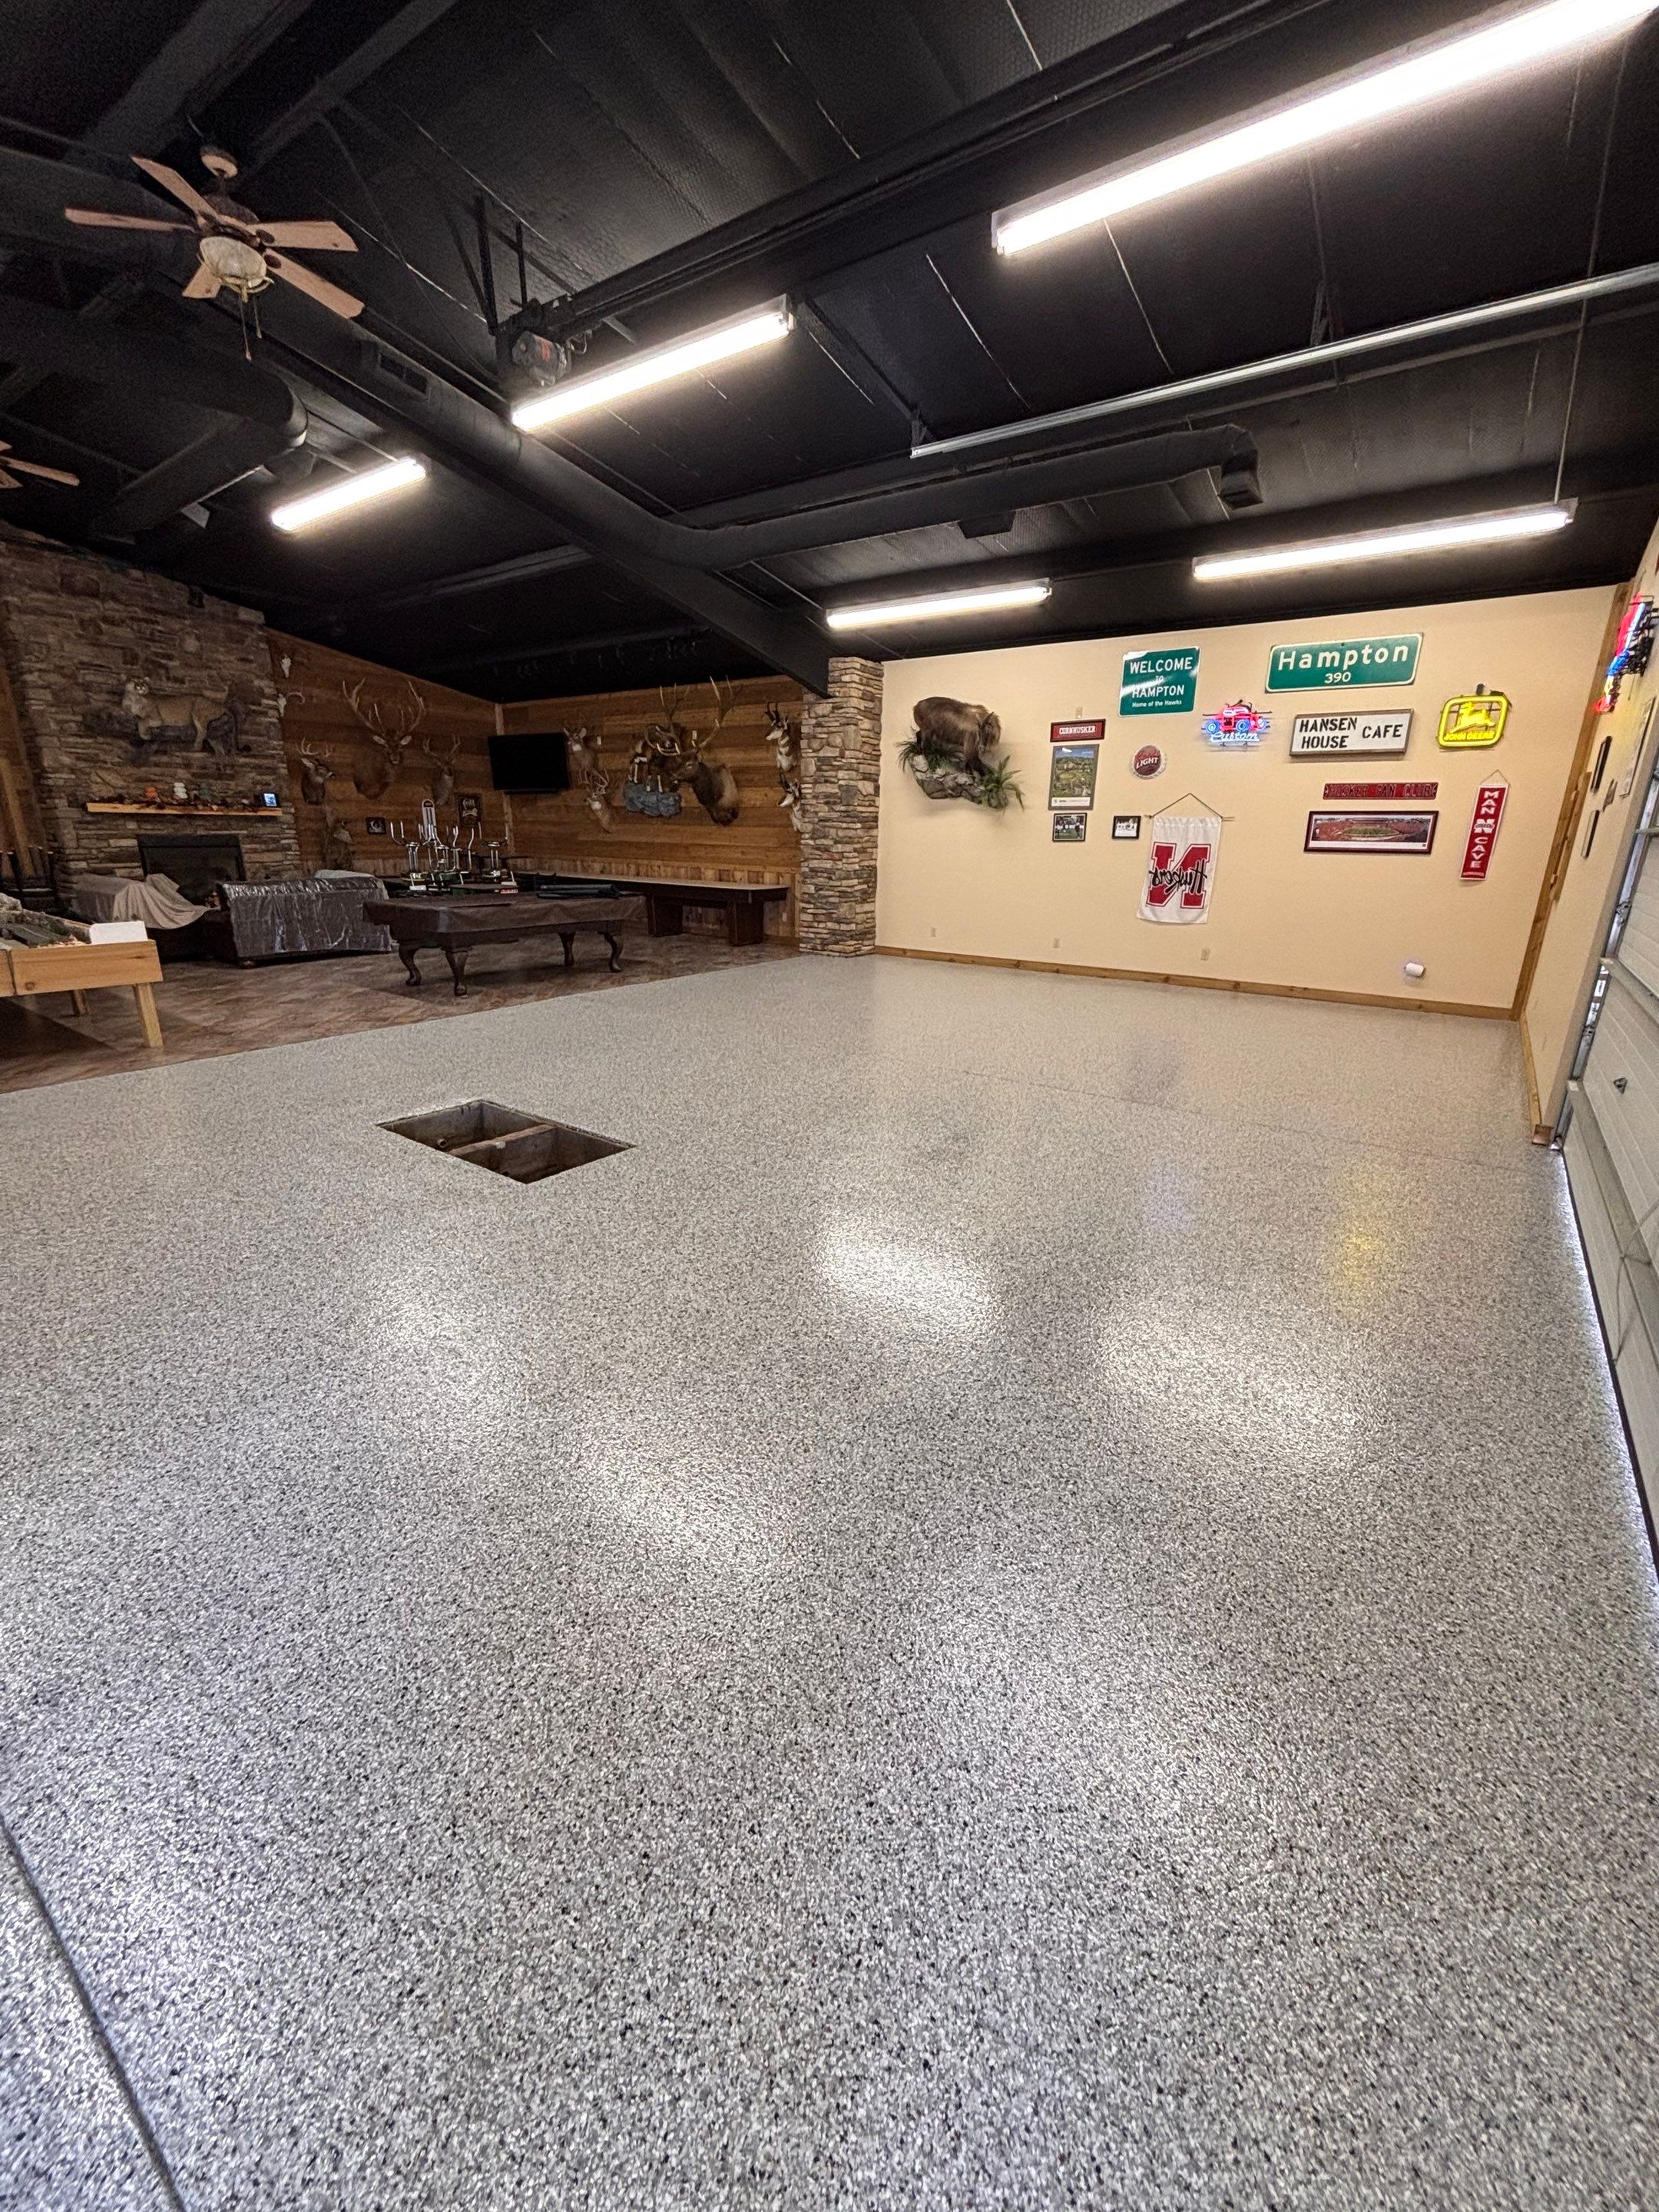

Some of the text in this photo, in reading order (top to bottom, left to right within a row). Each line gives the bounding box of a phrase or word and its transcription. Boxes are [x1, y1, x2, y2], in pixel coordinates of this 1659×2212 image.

[1278, 644, 1409, 671] Hampton
[1130, 657, 1193, 674] WELCOME
[1324, 671, 1351, 684] 390
[1131, 684, 1184, 698] HAMPTON
[1059, 725, 1096, 735] CORNHUSKER
[1299, 717, 1357, 733] HANSEN
[1362, 724, 1403, 739] CAFE
[1210, 731, 1260, 742] Custom
[1301, 735, 1349, 749] HOUSE
[1466, 730, 1495, 740] DEERE
[1136, 757, 1158, 770] LIGHT
[1329, 784, 1369, 797] HUSKER
[1402, 783, 1433, 797] CLUB
[1481, 790, 1499, 815] MAN
[1470, 836, 1488, 869] CAVE
